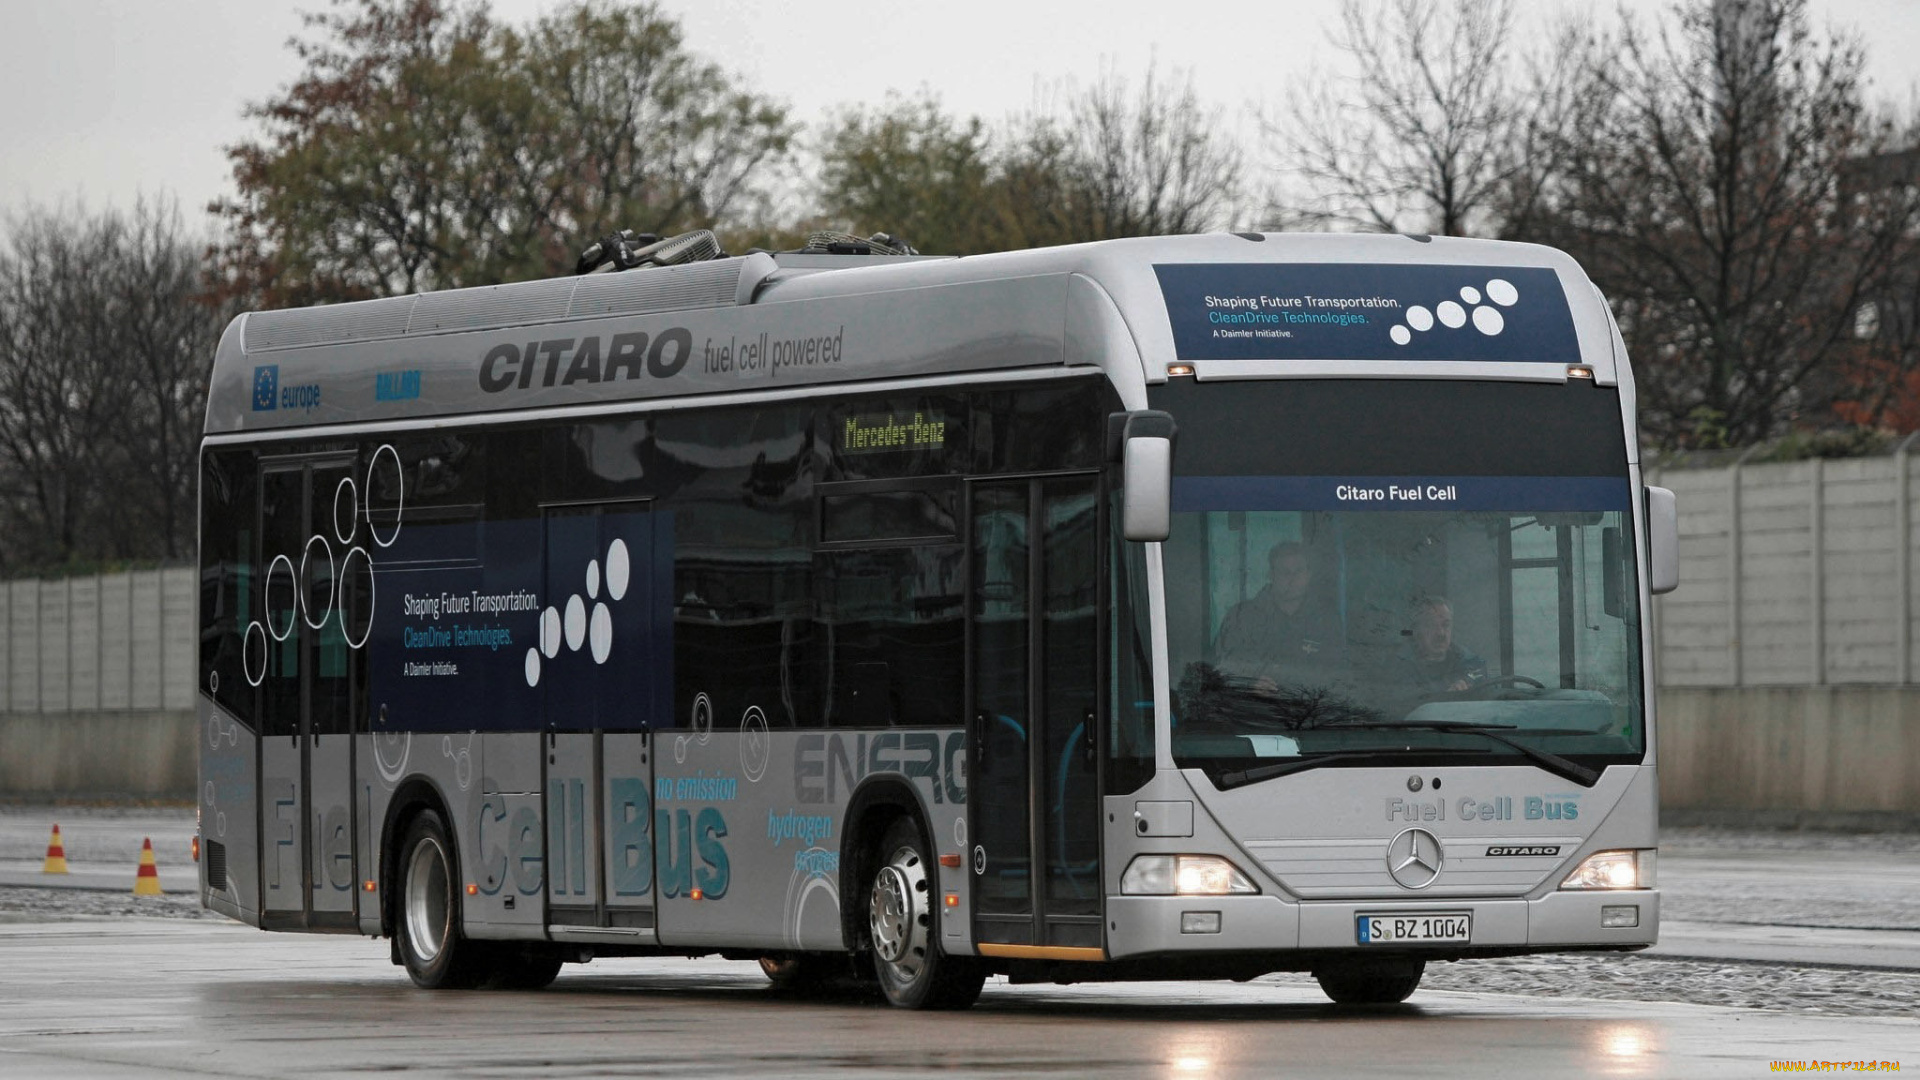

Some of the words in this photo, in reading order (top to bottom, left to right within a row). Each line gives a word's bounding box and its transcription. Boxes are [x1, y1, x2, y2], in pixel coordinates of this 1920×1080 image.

[1205, 295, 1259, 310] Shaping
[1260, 295, 1302, 308] Future
[1304, 295, 1402, 310] Transportation.
[1209, 311, 1279, 324] CleanDrive
[1282, 311, 1370, 326] Technologies.
[1213, 329, 1220, 338] A
[1221, 329, 1253, 338] Daimler
[1255, 329, 1294, 338] Initiative.
[478, 327, 692, 393] CITARO
[704, 337, 735, 374] fuel
[739, 332, 768, 371] cell
[772, 325, 844, 377] powered
[281, 384, 321, 414] europe
[845, 412, 945, 448] Mercedes-Benz
[1336, 485, 1385, 500] Citaro
[1389, 485, 1422, 500] Fuel
[1426, 485, 1457, 500] Cell
[404, 593, 440, 621] Shaping
[441, 592, 470, 614] Future
[471, 588, 540, 618] Transportation.
[404, 625, 451, 649] CleanDrive
[453, 623, 513, 651] Technologies.
[404, 662, 409, 676] A
[409, 662, 432, 676] Daimler
[432, 661, 459, 675] Initiative.
[656, 777, 673, 800] no
[676, 768, 739, 800] emission
[1384, 797, 1446, 822] Fuel
[1455, 796, 1513, 821] Cell
[1523, 795, 1580, 821] Bus
[264, 777, 373, 892] Fuel
[467, 777, 586, 896] Cell
[609, 778, 731, 901] Bus
[767, 807, 833, 848] hydrogen
[1488, 846, 1560, 856] CITARO
[1371, 920, 1382, 938] S
[1394, 919, 1418, 938] BZ
[1422, 919, 1466, 938] 1004
